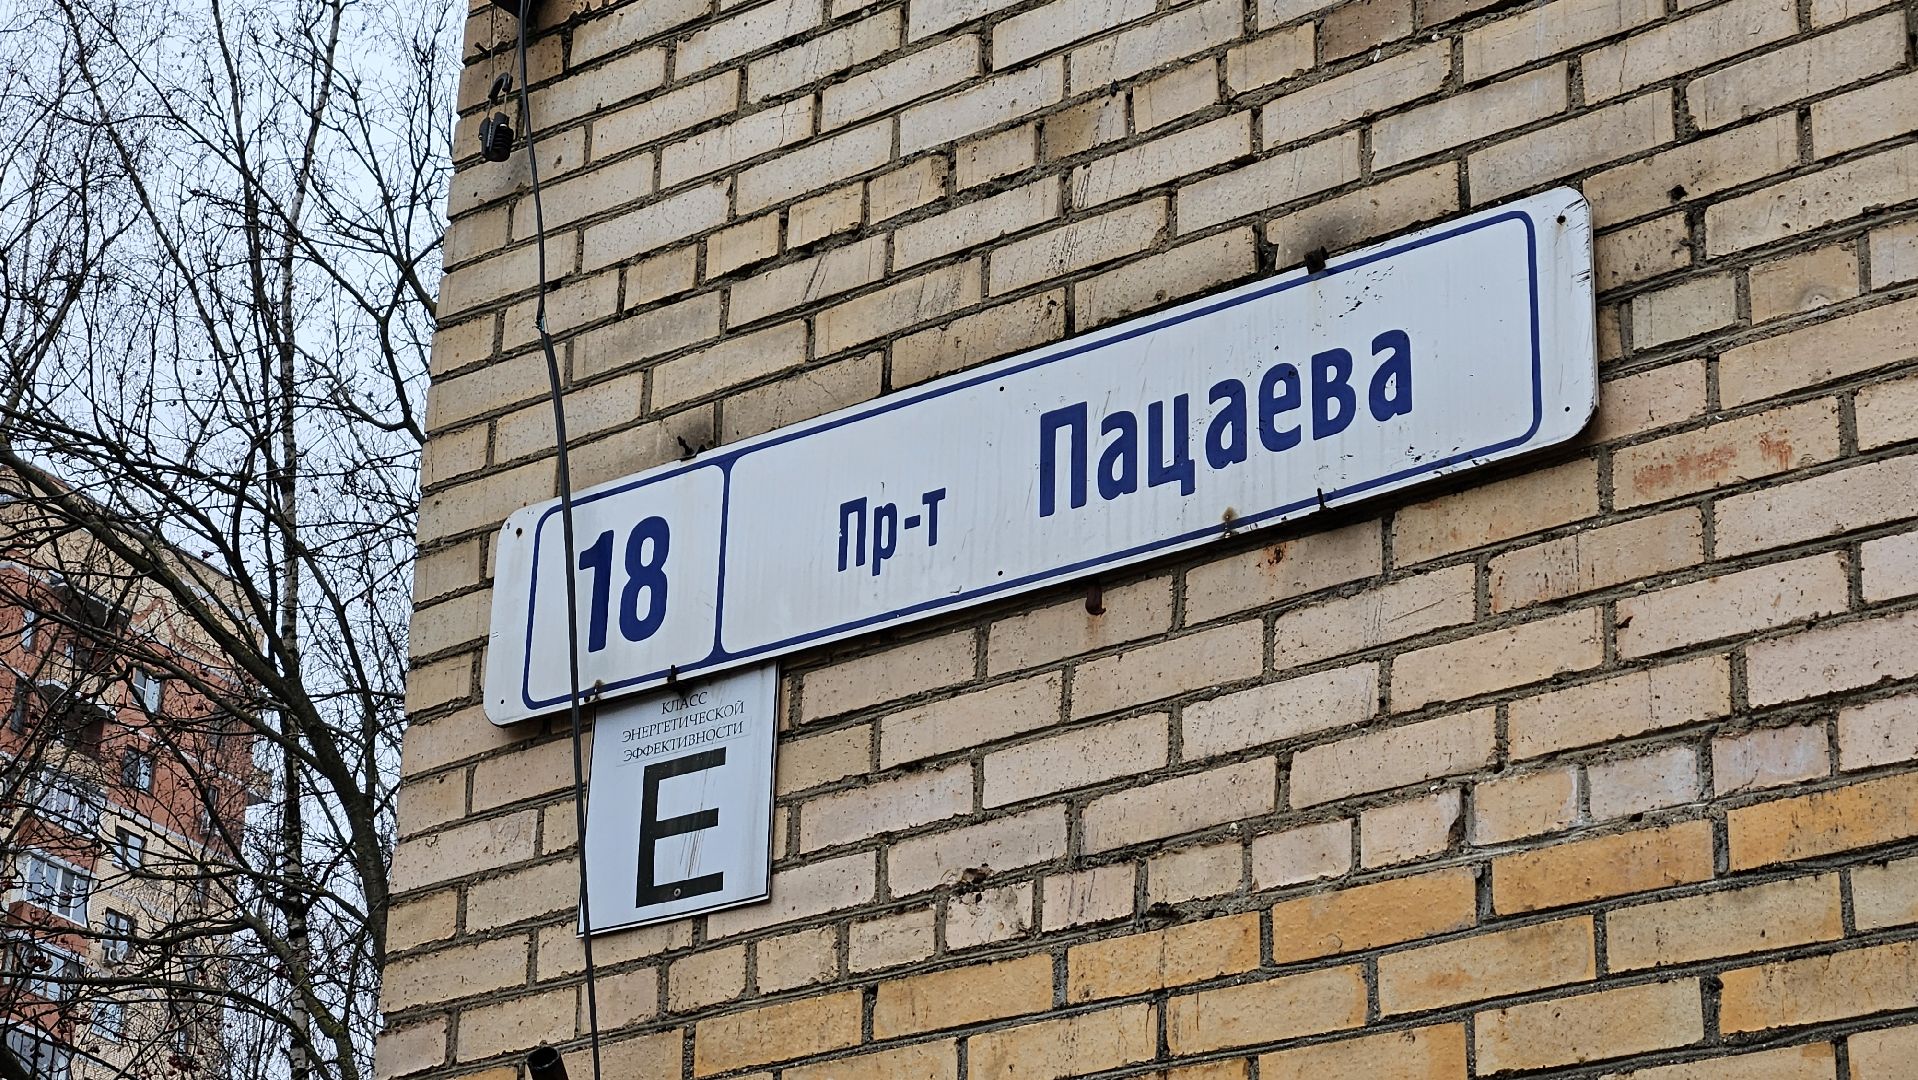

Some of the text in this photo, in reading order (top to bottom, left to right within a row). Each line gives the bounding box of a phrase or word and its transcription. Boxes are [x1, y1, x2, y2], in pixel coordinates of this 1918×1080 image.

[837, 329, 1413, 576] Пр-т Пацаева
[578, 515, 670, 652] 18
[621, 700, 745, 743] ЭНЕРГЕТИЧЕСКОЙ
[661, 691, 708, 715] КЛАСС
[623, 720, 744, 762] ЭФФЕКТИВНОСТИ
